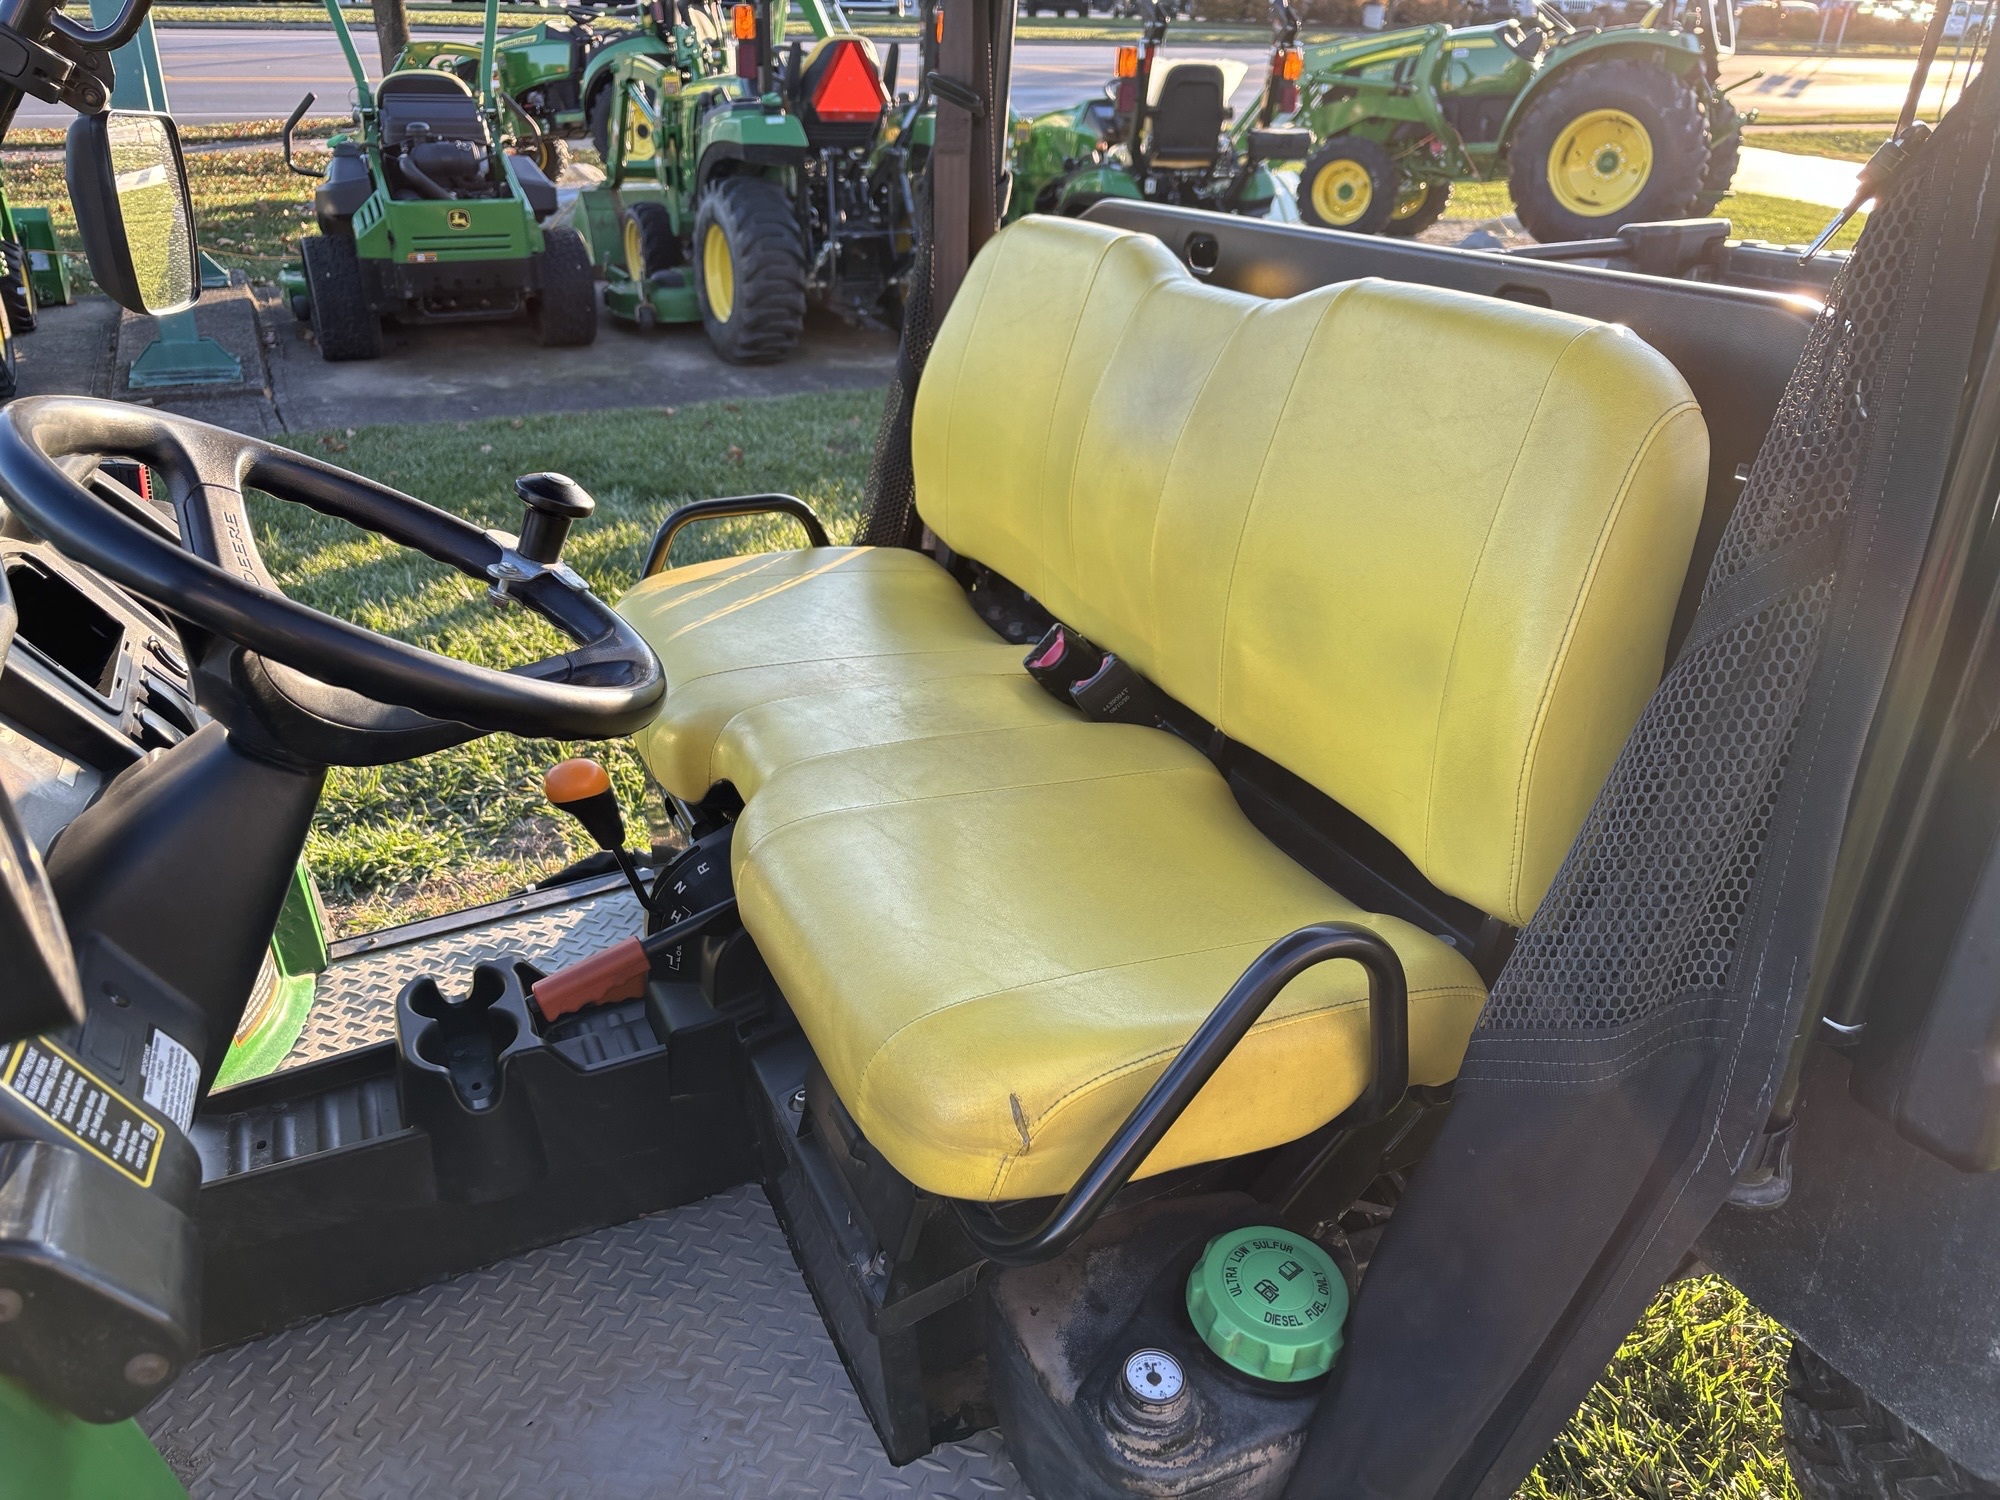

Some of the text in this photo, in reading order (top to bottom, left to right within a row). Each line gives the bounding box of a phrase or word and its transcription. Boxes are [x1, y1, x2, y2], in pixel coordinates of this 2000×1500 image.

[697, 862, 710, 874] R
[674, 880, 686, 894] N
[670, 910, 682, 924] H
[13, 1046, 40, 1093] HELP PREVENT
[25, 1056, 50, 1100] INJURY WHEN
[37, 1056, 64, 1108] DUMPING LOADS
[60, 1069, 76, 1087] brake
[58, 1085, 70, 1102] park
[62, 1076, 88, 1123] before dumping
[76, 1090, 99, 1132] Operate dump
[88, 1128, 98, 1139] on
[97, 1092, 110, 1116] ground
[100, 1130, 112, 1146] only
[112, 1120, 132, 1156] Keep hands
[124, 1130, 140, 1163] away from
[135, 1138, 150, 1170] cargo box
[1226, 1240, 1294, 1298] ULTRA LOW SULFUR
[1264, 1270, 1329, 1327] DIESEL FUEL ONLY
